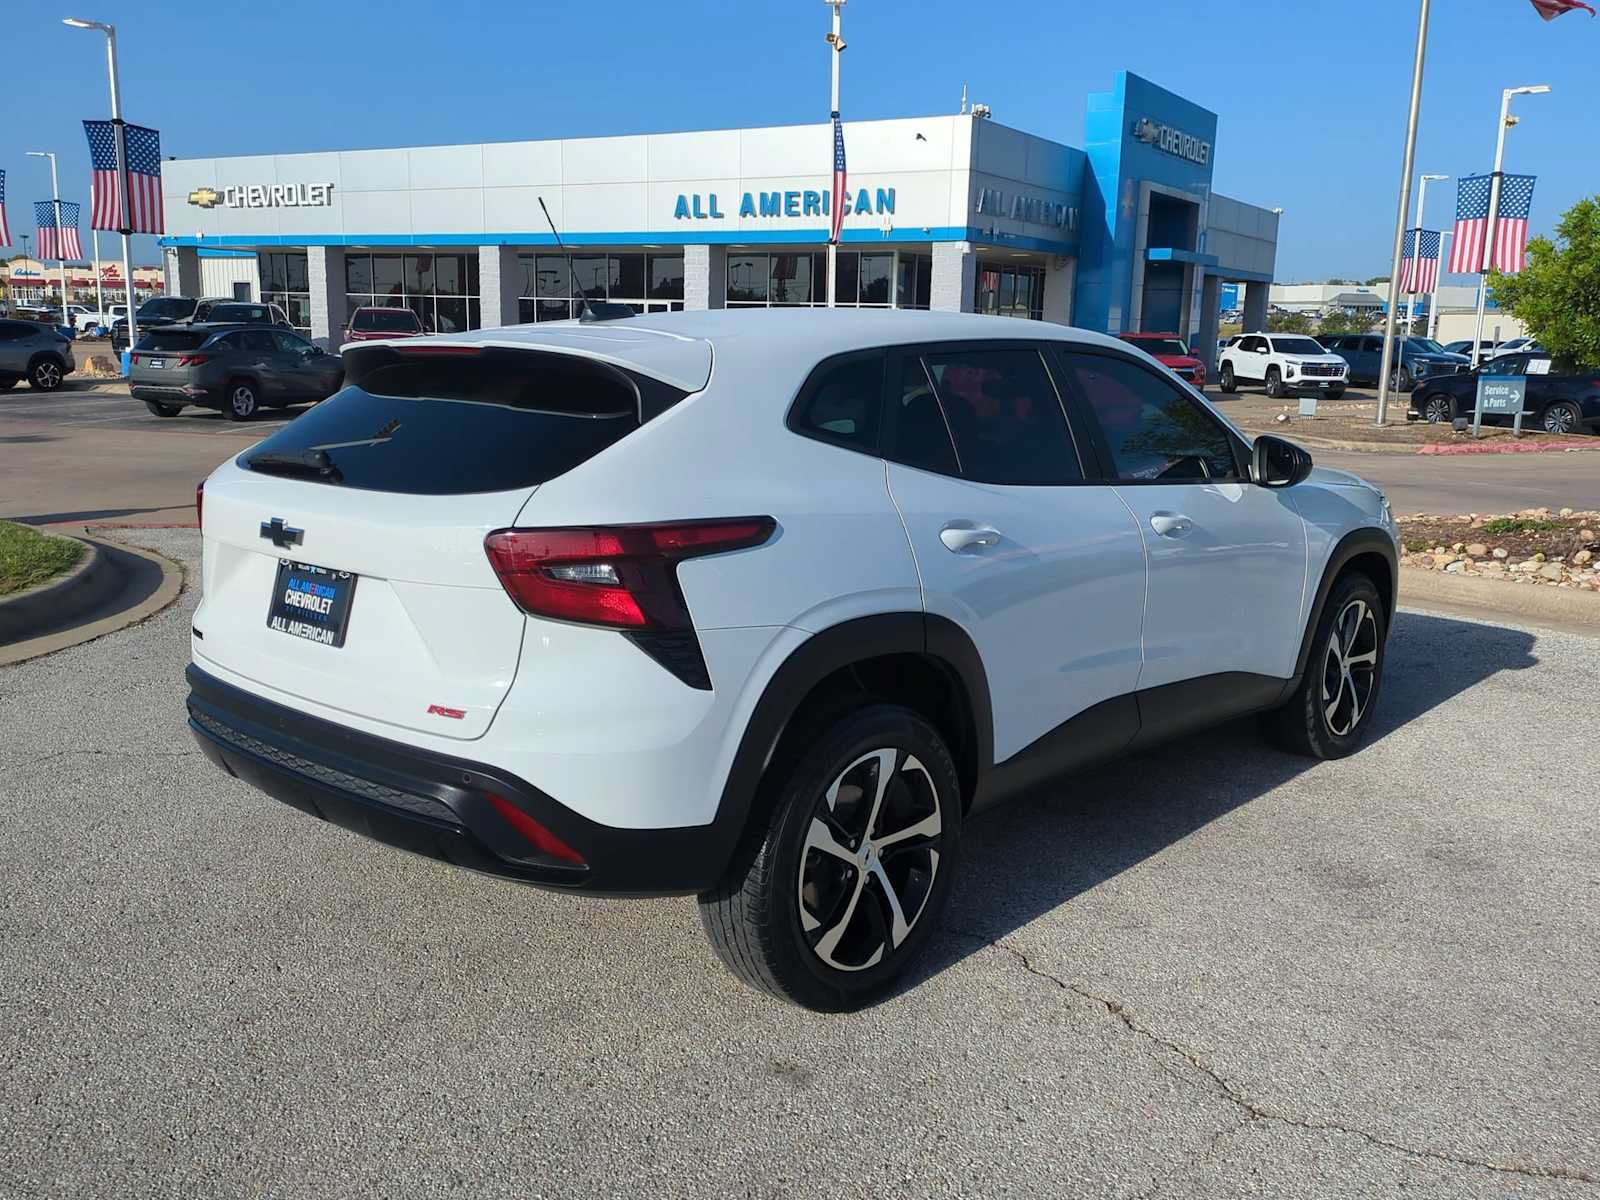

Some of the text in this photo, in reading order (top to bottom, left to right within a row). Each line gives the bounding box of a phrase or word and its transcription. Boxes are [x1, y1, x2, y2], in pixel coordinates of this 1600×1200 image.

[1160, 125, 1211, 168] CHEVROLET
[224, 183, 334, 208] CHEVROLET
[674, 193, 725, 219] ALL
[1484, 385, 1509, 395] Service
[1490, 398, 1506, 408] Parts
[288, 576, 300, 590] ALL
[284, 588, 333, 615] CHEVROLET
[271, 616, 335, 645] ALL AMERICAN
[427, 704, 467, 720] RS
